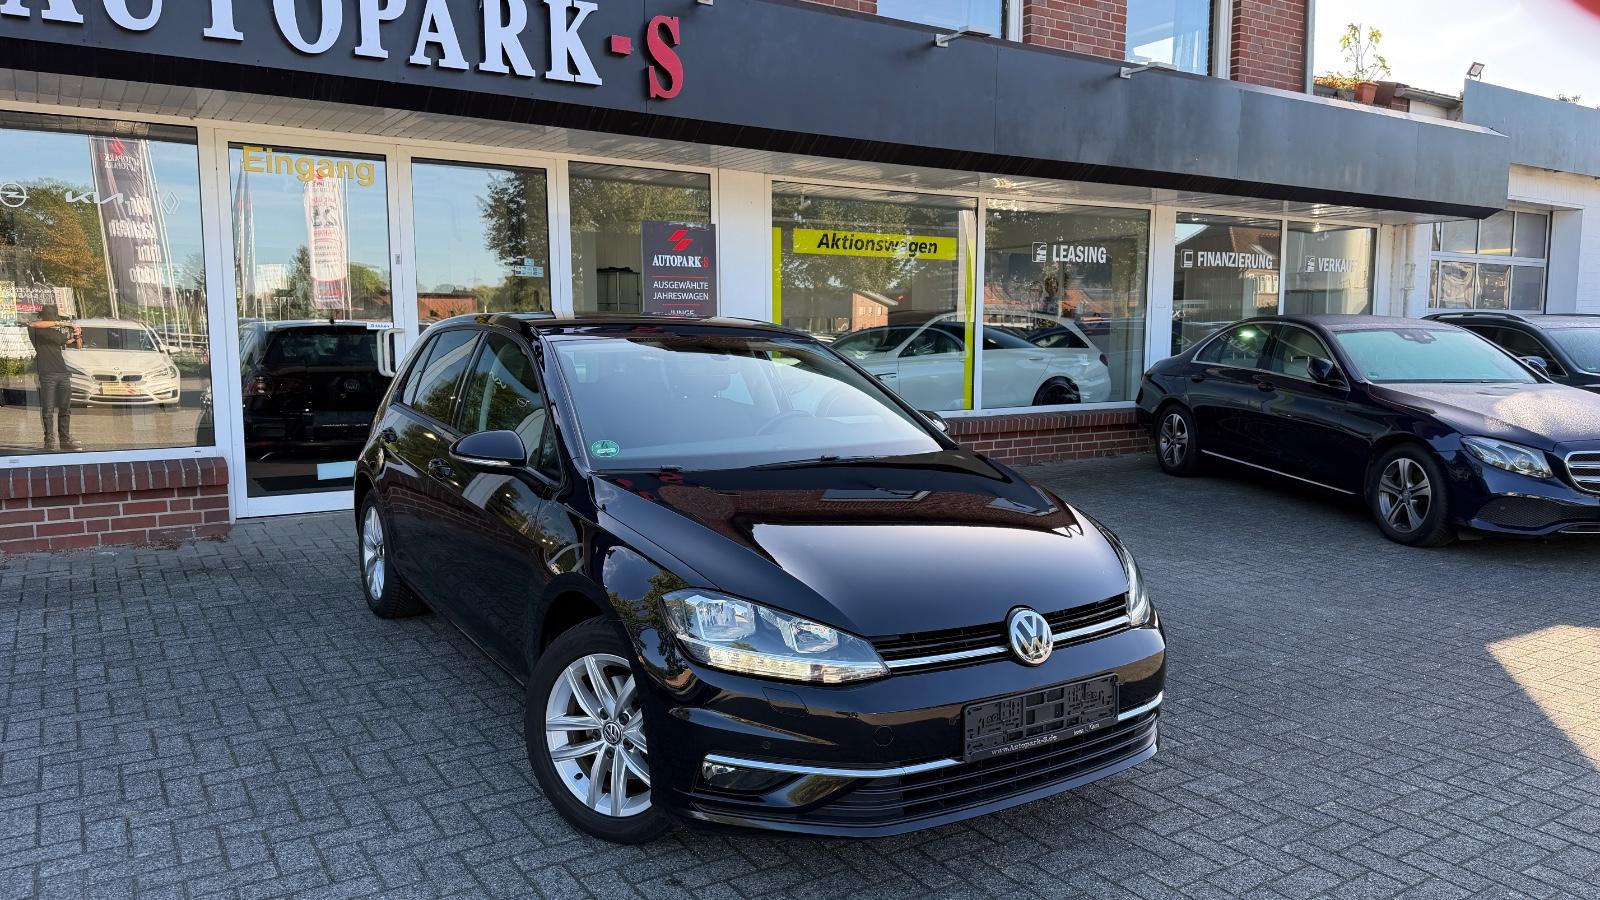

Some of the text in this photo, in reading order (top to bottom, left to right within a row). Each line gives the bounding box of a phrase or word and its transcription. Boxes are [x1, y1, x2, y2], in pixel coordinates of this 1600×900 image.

[0, 0, 684, 99] OPARK-S
[242, 146, 375, 187] Eingang
[1052, 244, 1107, 264] LEASING
[1197, 251, 1273, 270] FINANZIERUNG
[652, 279, 710, 291] AUSGEWÄHLTE
[652, 291, 710, 301] JAHRESWAGEN
